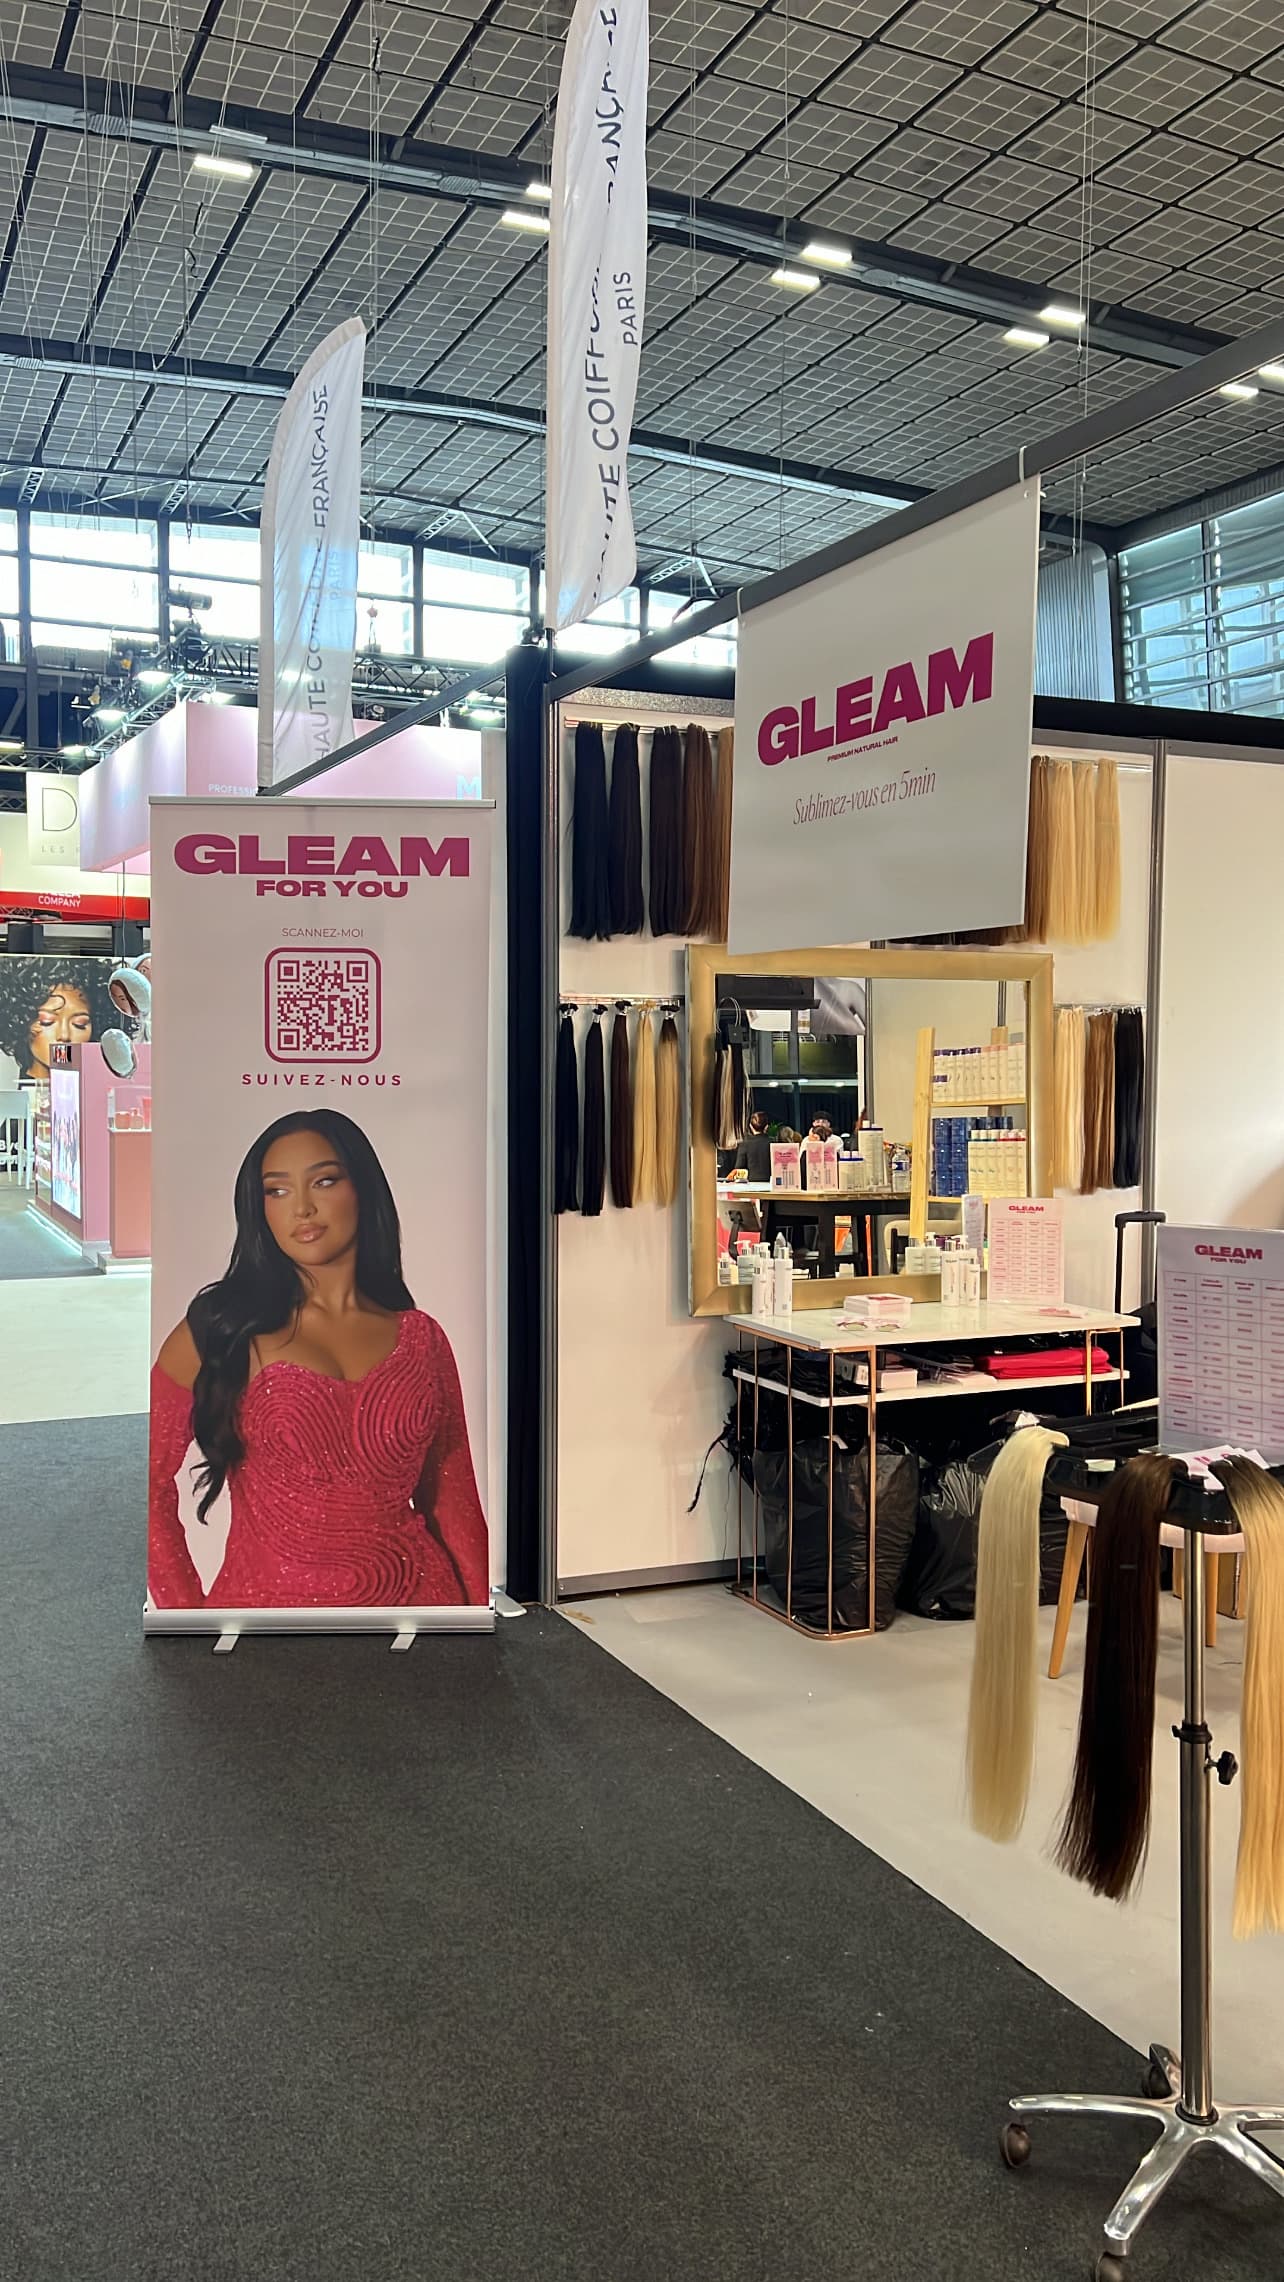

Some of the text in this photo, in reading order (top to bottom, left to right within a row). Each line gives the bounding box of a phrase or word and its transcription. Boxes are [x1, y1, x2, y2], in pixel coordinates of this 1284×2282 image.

[612, 271, 638, 346] PARIS
[311, 384, 329, 528] FRANÇAISE
[757, 631, 994, 766] GLEAM
[308, 679, 330, 760] HAUTE
[827, 735, 898, 762] PREMIUM NATURAL HAIR
[793, 767, 936, 825] Sublimez-vous en 5min
[173, 833, 470, 877] GLEAM
[38, 895, 81, 908] COMPANY
[256, 879, 409, 898] FOR YOU
[281, 927, 364, 939] SCANNEZ-MOI
[241, 1073, 402, 1087] SUIVEZ-NOUS
[1008, 1204, 1045, 1212] GLEAM
[1194, 1244, 1264, 1260] GLEAM
